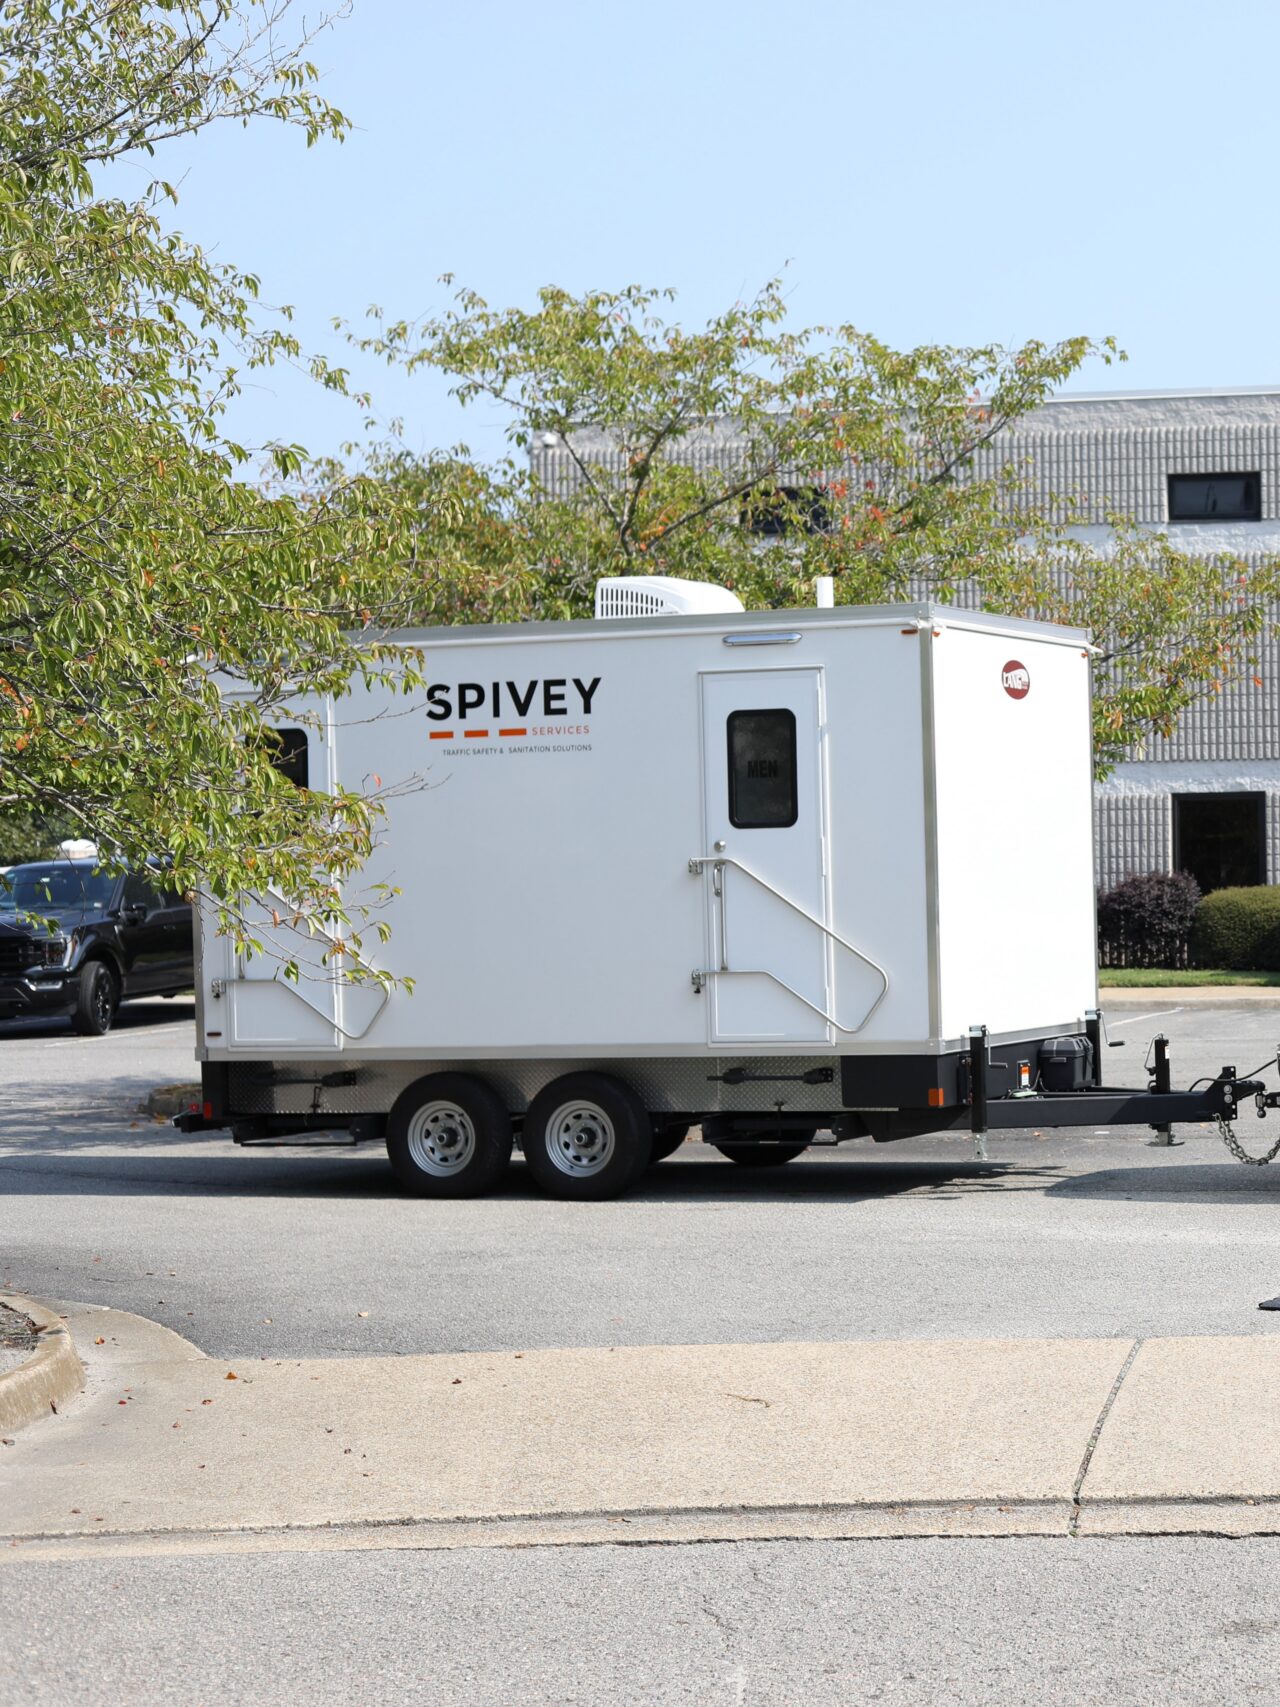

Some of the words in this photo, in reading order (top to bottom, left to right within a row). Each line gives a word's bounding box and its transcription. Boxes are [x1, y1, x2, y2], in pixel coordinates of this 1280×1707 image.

[426, 677, 602, 721] SPIVEY
[532, 725, 590, 736] SERVICES
[443, 748, 471, 757] TRAFFIC
[472, 747, 498, 756] SAFETY
[508, 745, 550, 755] SANITATION
[552, 743, 593, 753] SOLUTIONS
[747, 760, 778, 778] MEN
